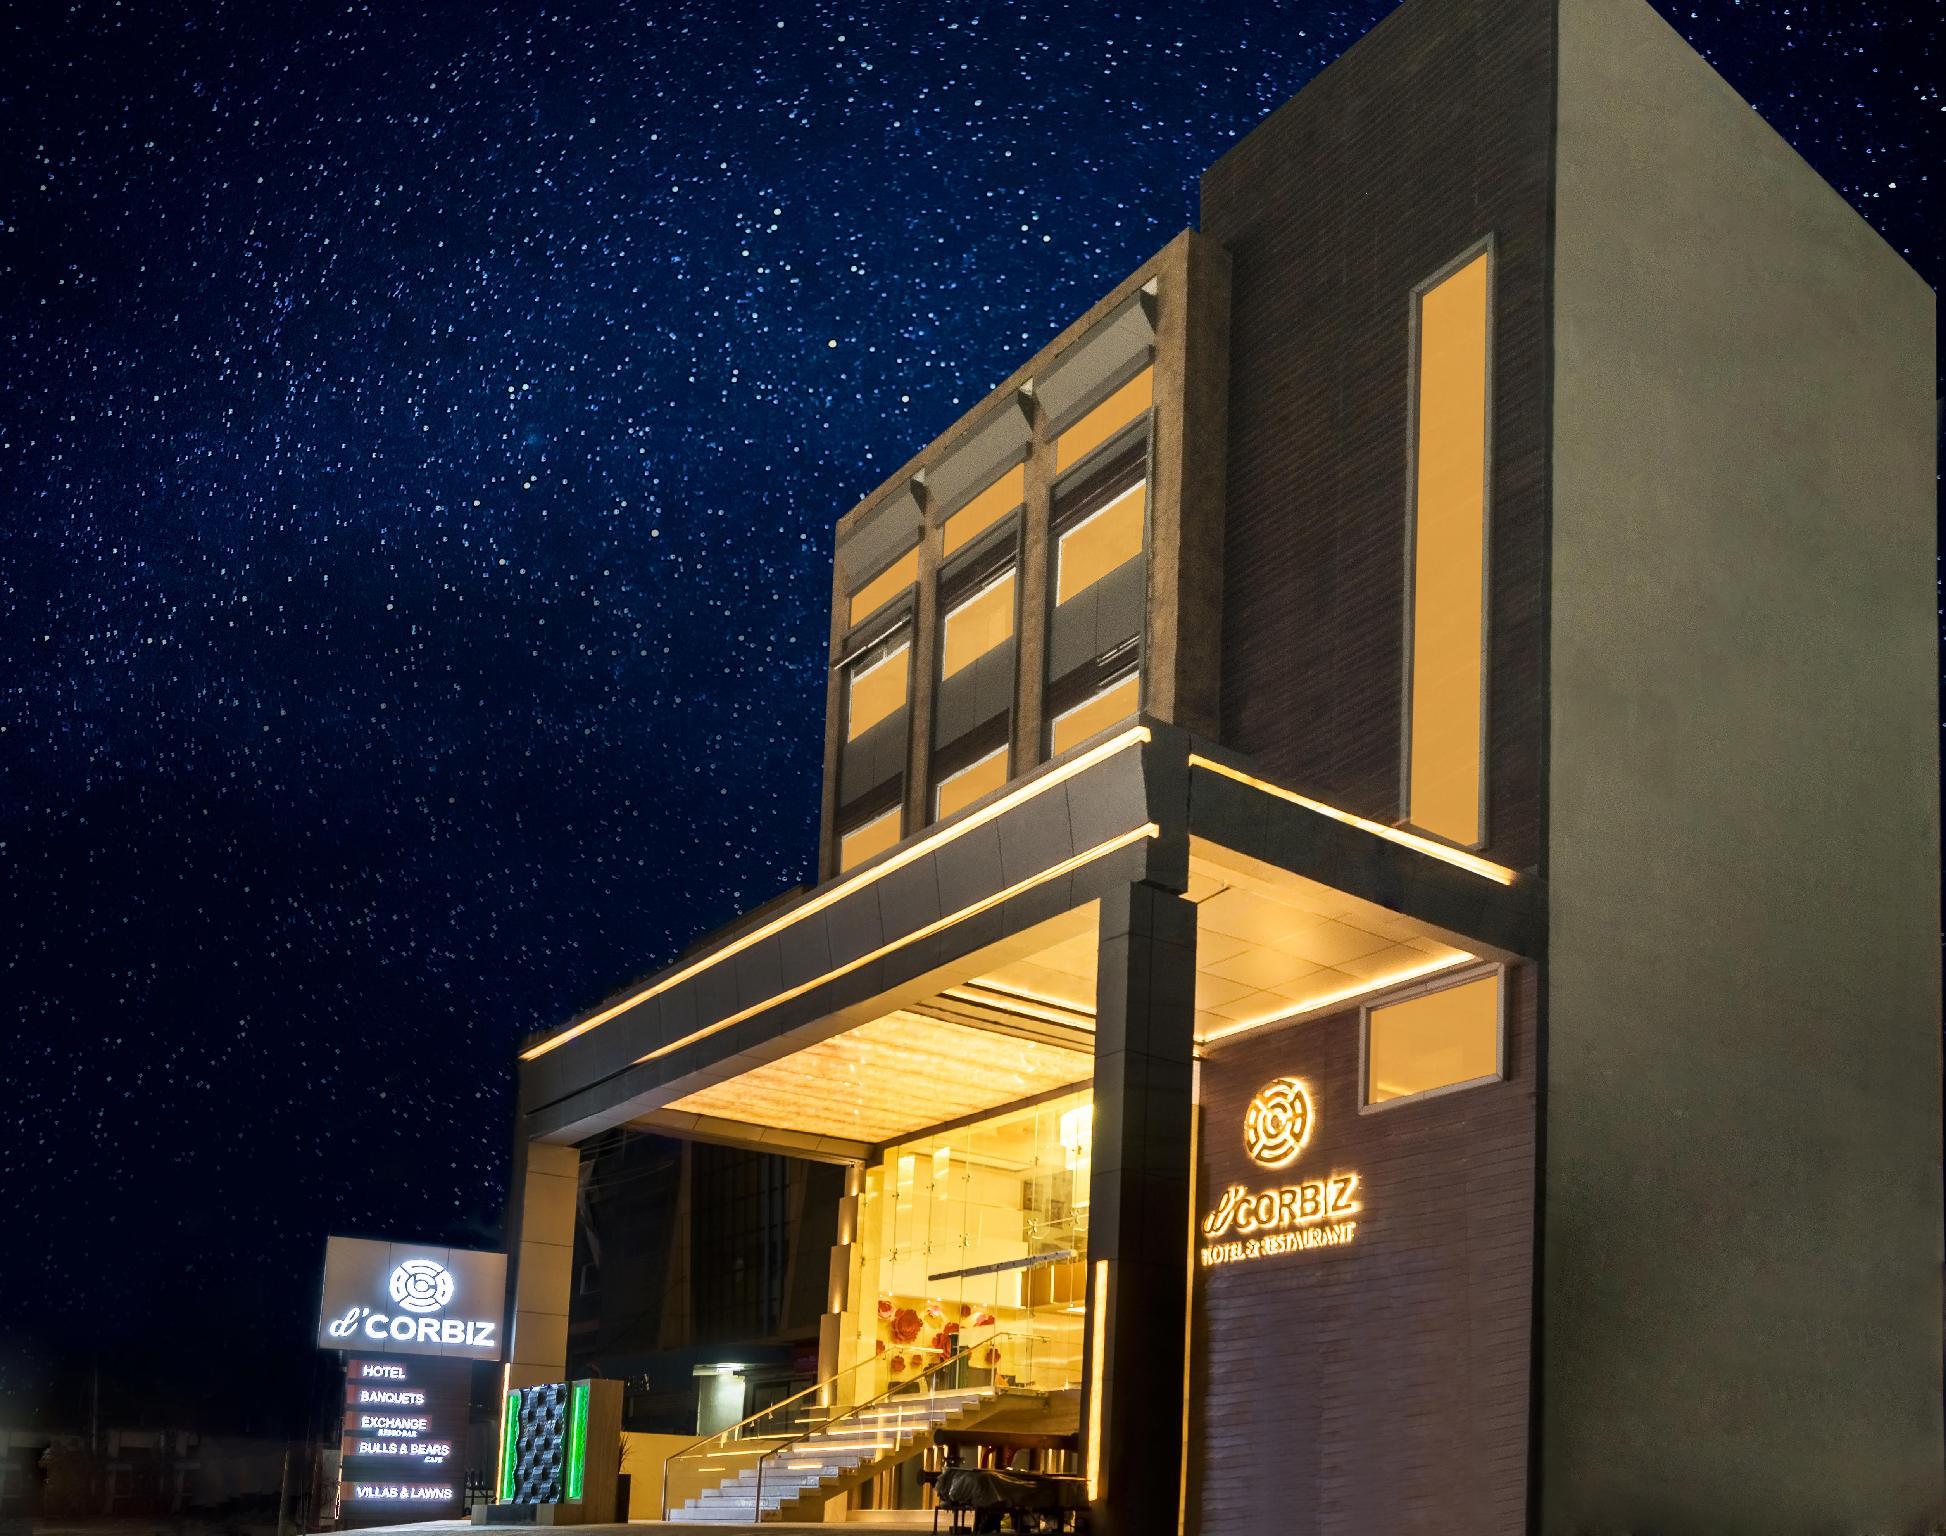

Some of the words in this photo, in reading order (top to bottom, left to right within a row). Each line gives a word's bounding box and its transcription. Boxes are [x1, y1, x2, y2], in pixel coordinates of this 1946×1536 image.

[1201, 1242, 1246, 1266] HOTEL
[1246, 1239, 1260, 1258] &
[1261, 1222, 1357, 1255] RESTAURANT
[329, 1307, 496, 1347] d'CORBIZ
[363, 1365, 406, 1378] HOTEL
[361, 1391, 425, 1405] BANQUETS
[361, 1416, 428, 1430] EXCHANGE
[359, 1442, 398, 1455] BULLS
[400, 1444, 409, 1455] &
[410, 1444, 451, 1456] BEARS
[357, 1486, 398, 1499] VILLAS
[400, 1487, 409, 1499] &
[411, 1487, 453, 1499] LAWNS
